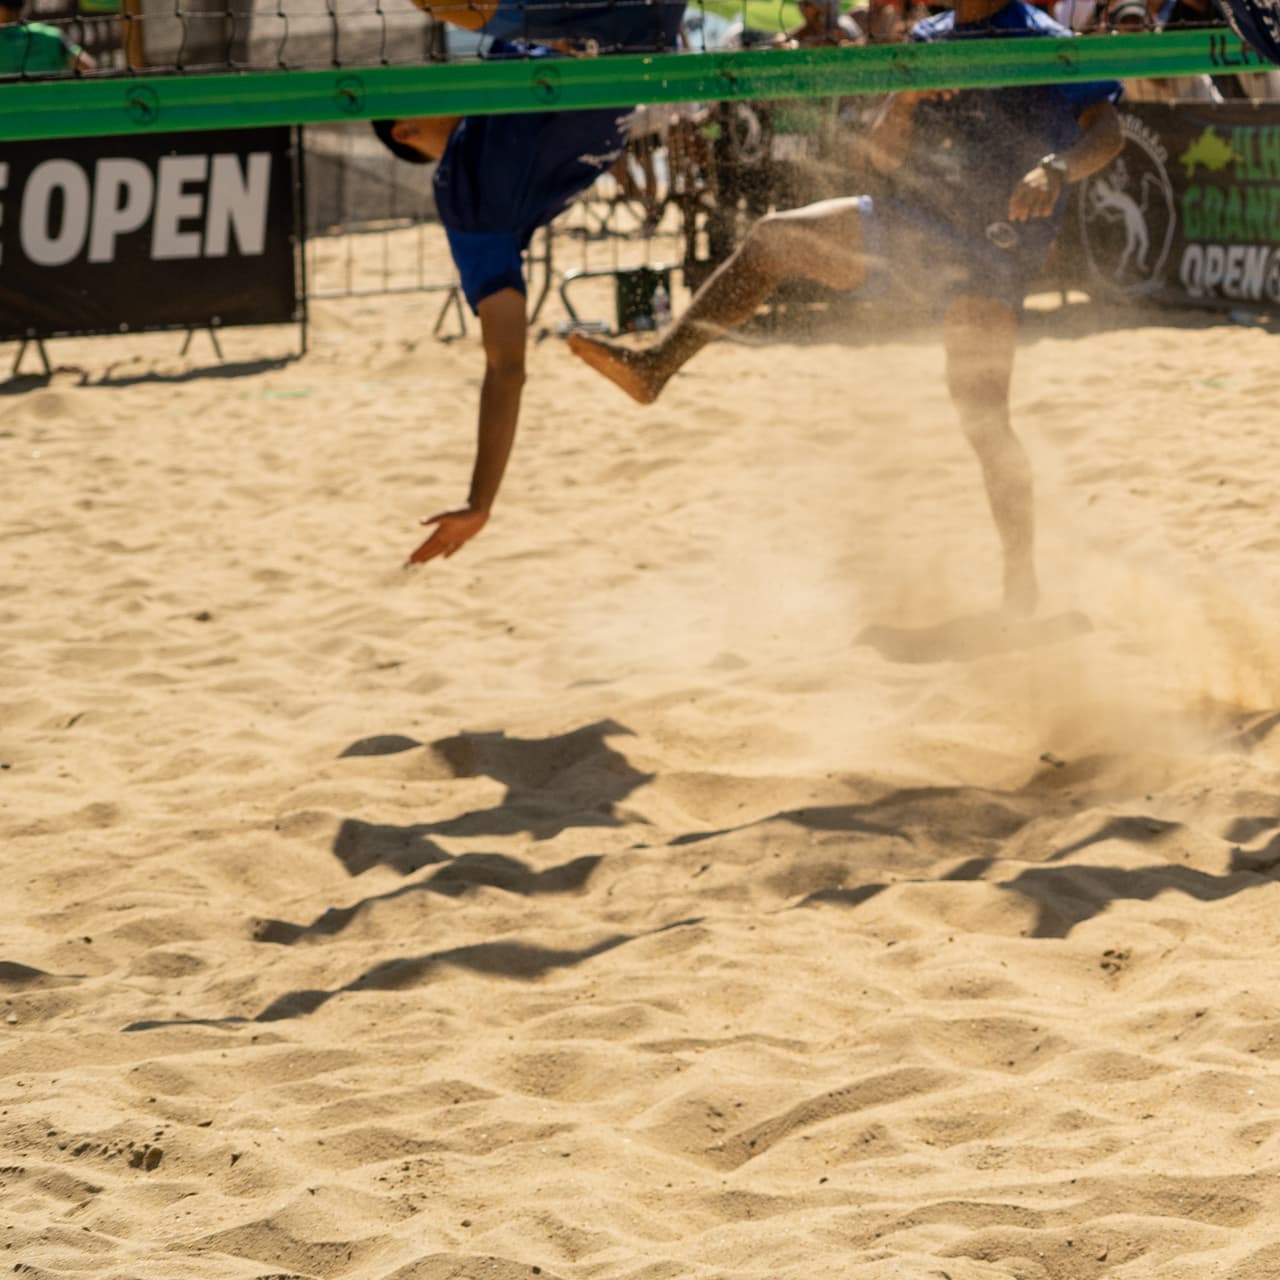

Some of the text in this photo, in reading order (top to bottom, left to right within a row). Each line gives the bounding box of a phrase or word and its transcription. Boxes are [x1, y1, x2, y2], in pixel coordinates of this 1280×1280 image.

[1209, 33, 1266, 68] ILH
[18, 151, 272, 267] OPEN
[1180, 243, 1269, 300] OPEN
